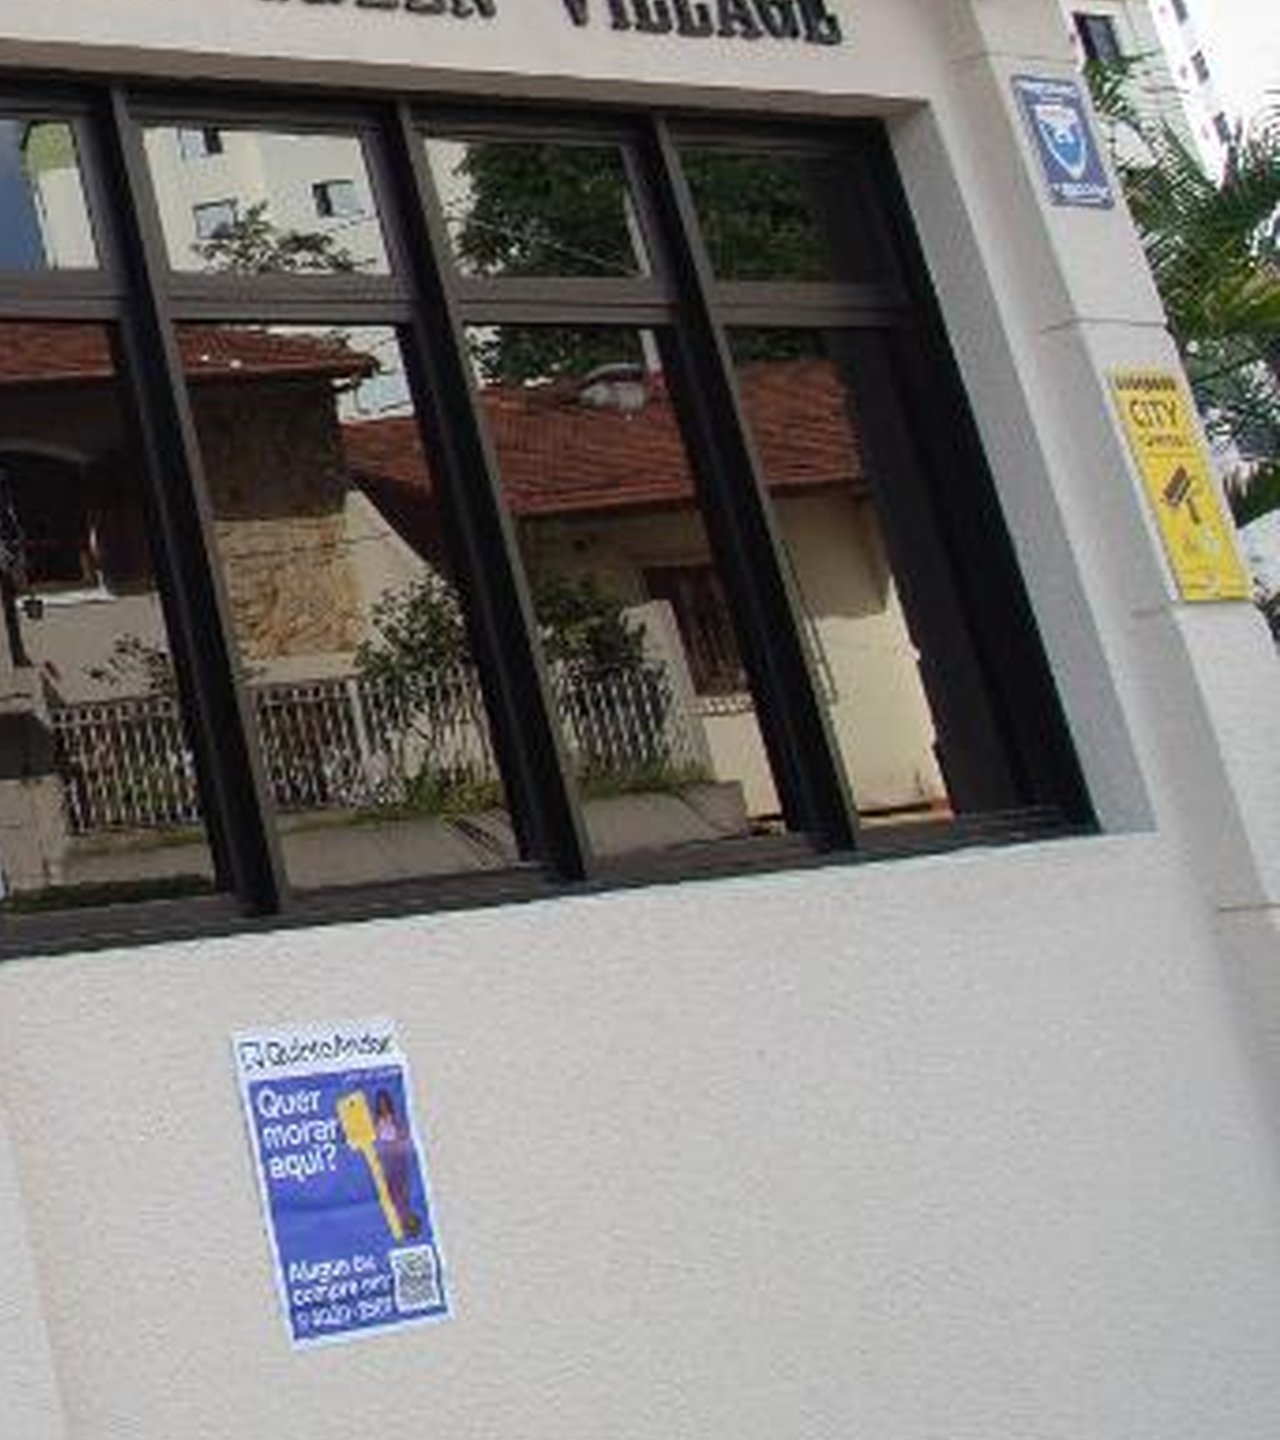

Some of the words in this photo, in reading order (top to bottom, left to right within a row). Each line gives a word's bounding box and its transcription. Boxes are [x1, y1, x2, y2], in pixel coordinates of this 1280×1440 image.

[256, 1087, 322, 1118] Quer
[263, 1117, 338, 1150] morar
[269, 1143, 338, 1181] aqui?
